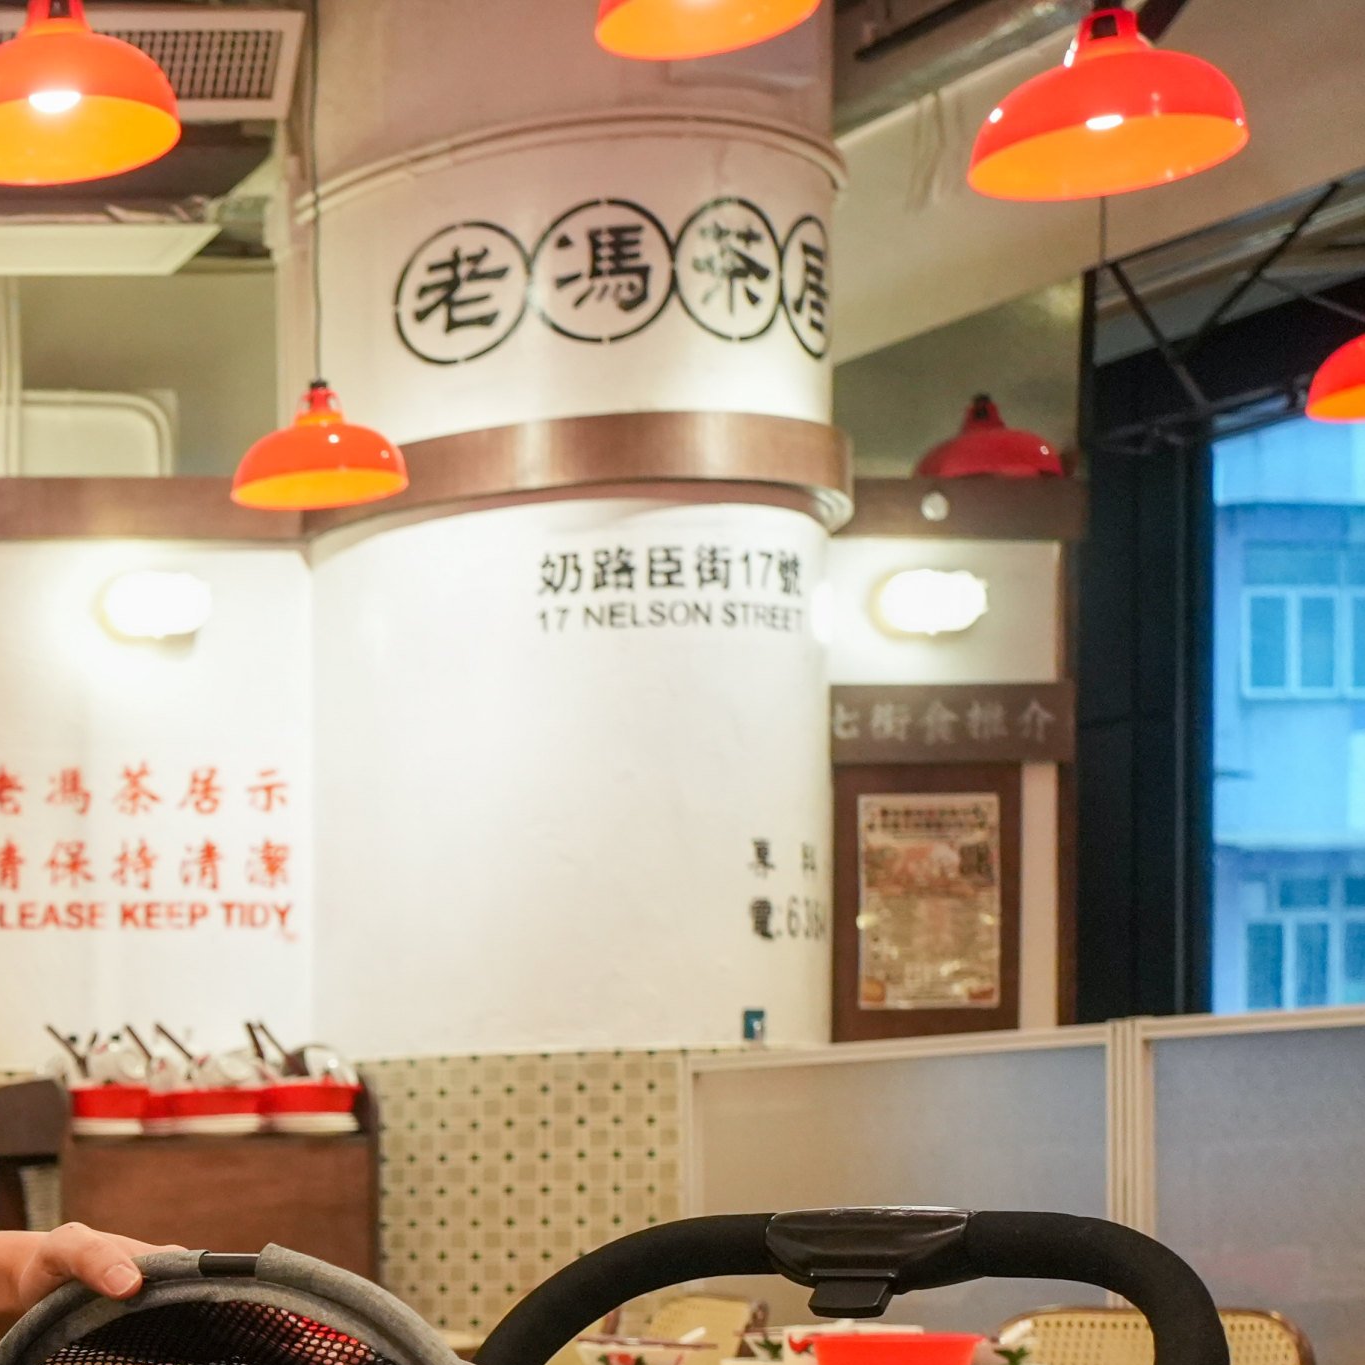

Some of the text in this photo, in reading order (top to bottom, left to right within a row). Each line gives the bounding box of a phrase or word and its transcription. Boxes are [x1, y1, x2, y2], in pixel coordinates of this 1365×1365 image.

[537, 545, 802, 598] 奶路臣街17號
[538, 600, 803, 632] 17 NELSON STREET
[120, 901, 210, 930] KEEP
[222, 901, 293, 930] TIDY
